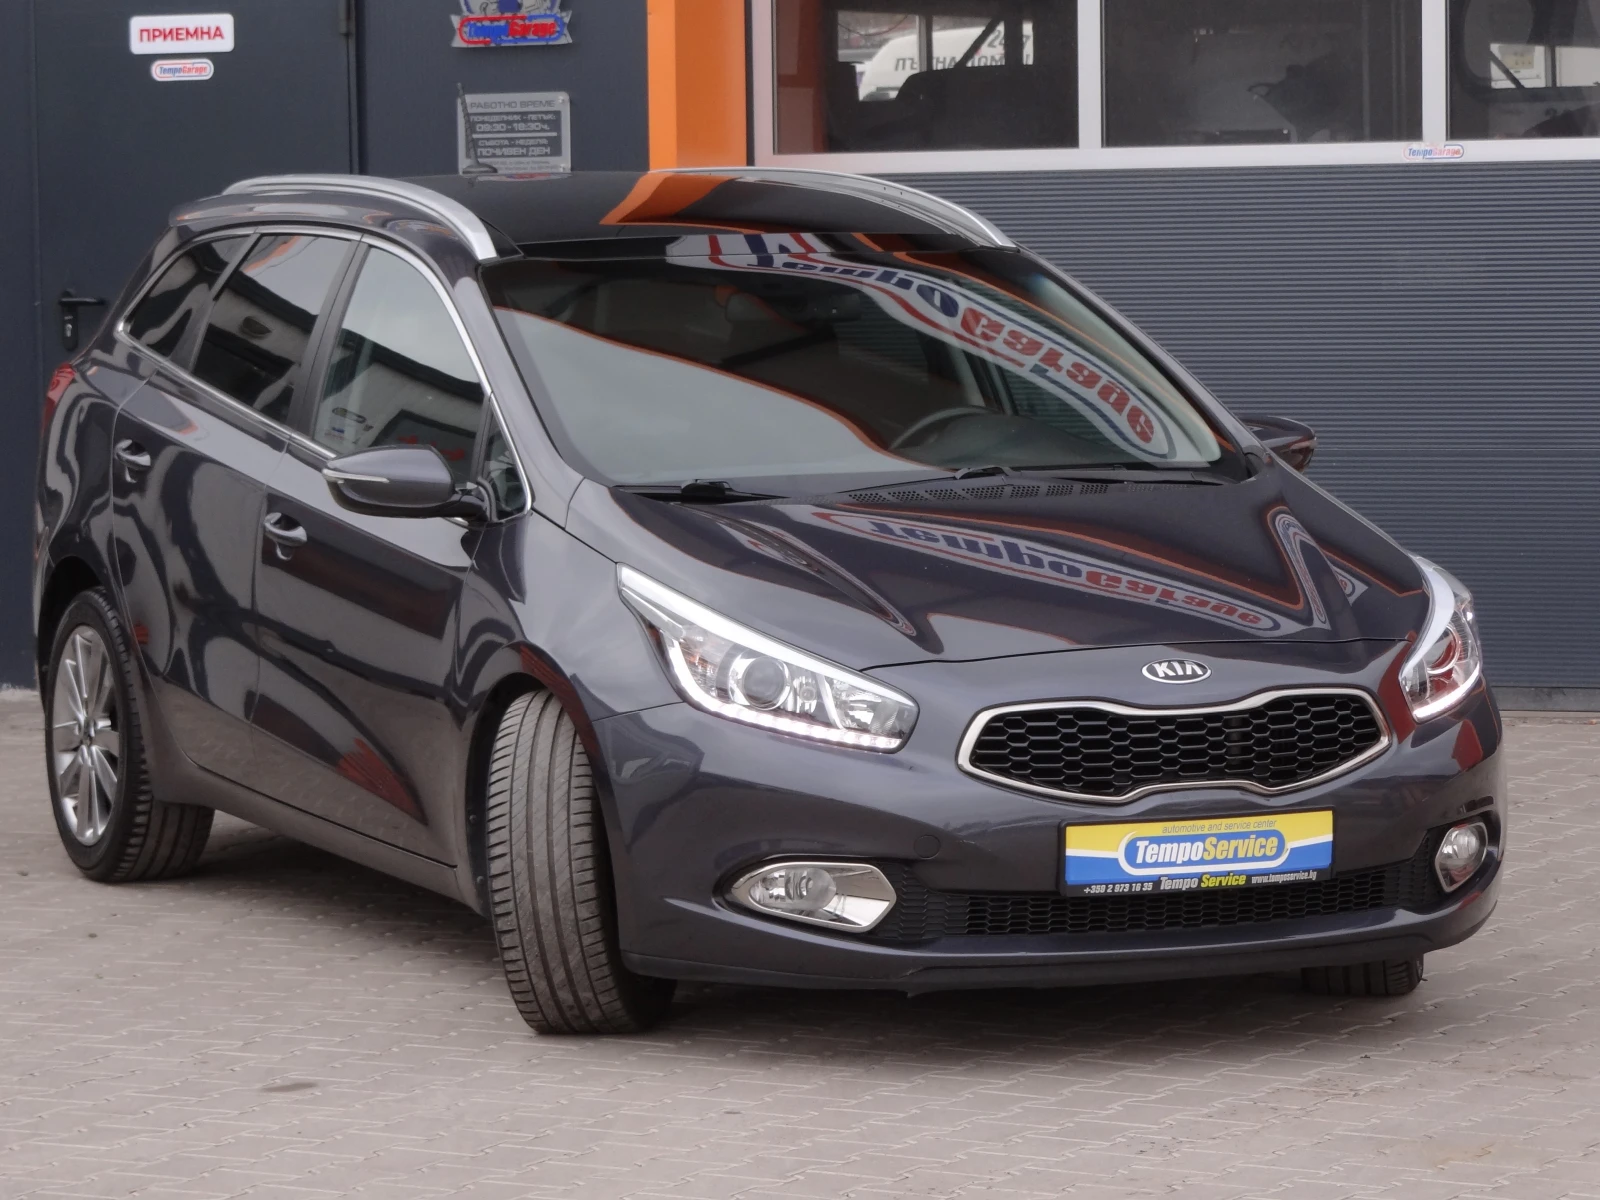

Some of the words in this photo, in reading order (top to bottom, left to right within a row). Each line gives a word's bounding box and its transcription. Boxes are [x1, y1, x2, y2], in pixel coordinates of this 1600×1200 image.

[139, 26, 225, 43] ПРИЕМНА
[159, 65, 208, 76] TempoGarage
[470, 101, 518, 110] РАБОТНО
[520, 100, 556, 109] ВРЕМЕ
[477, 147, 526, 156] ПОЧИВЕН
[529, 147, 551, 156] ДЕН
[1152, 660, 1204, 678] KIA
[1162, 823, 1205, 834] automotive
[1207, 821, 1222, 832] and
[1224, 821, 1251, 831] service
[1253, 819, 1277, 830] center
[1136, 836, 1278, 864] TempoService
[1084, 885, 1105, 894] +359
[1107, 885, 1113, 893] 2
[1114, 883, 1130, 892] 973
[1143, 882, 1153, 891] 35
[1160, 876, 1198, 890] Tempo
[1200, 873, 1246, 888] Service
